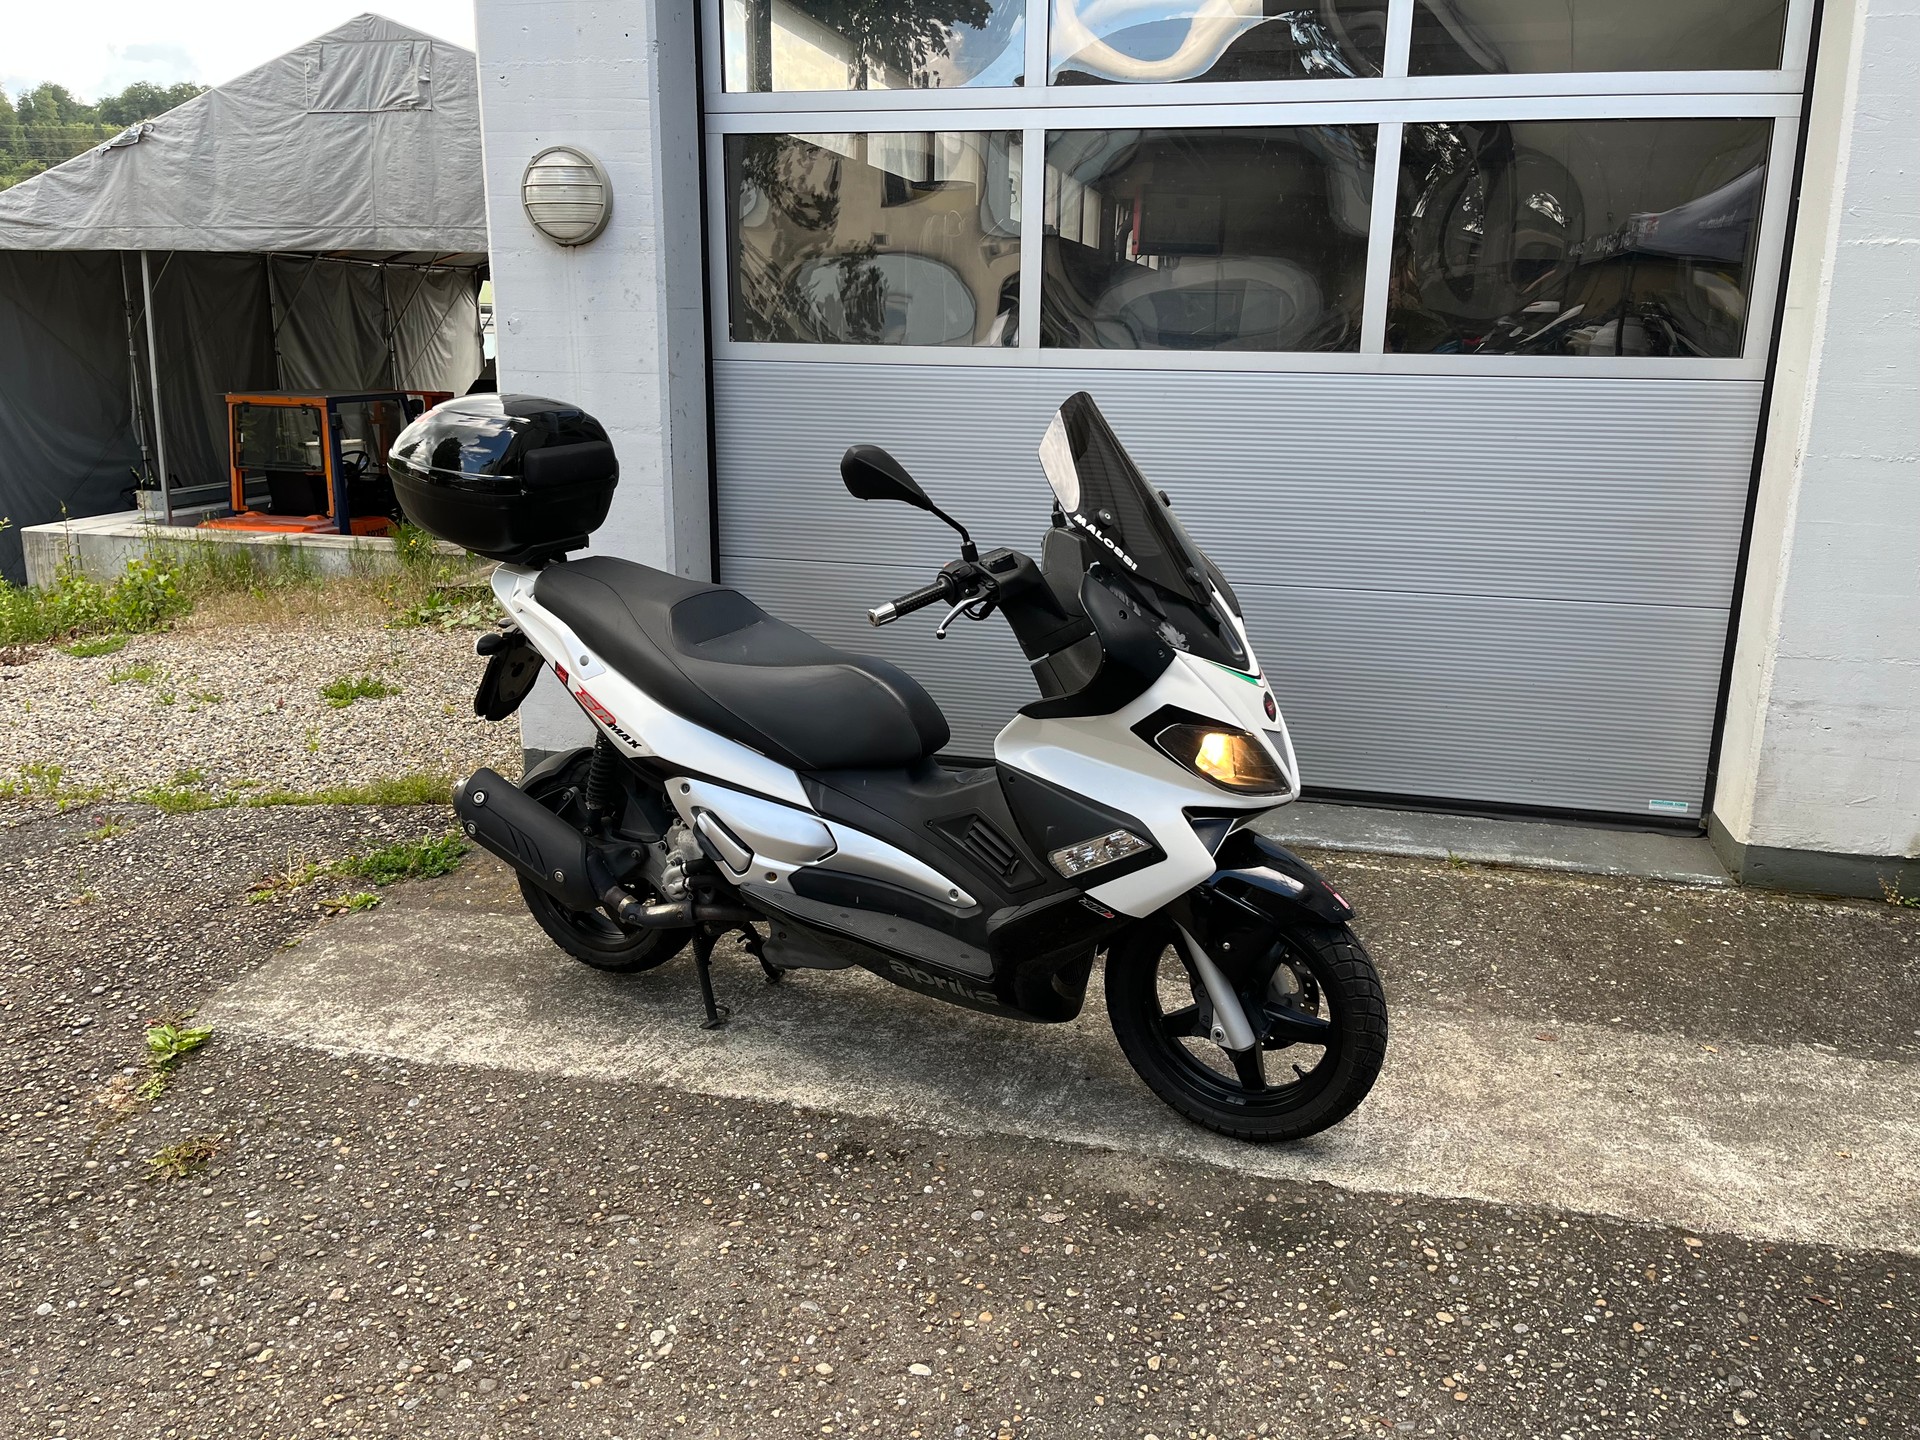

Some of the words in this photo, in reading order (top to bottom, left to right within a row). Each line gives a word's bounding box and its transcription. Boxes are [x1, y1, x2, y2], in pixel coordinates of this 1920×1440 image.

[364, 526, 390, 537] TOYOT
[1073, 514, 1138, 571] MALOSSI
[606, 722, 642, 749] MAX
[888, 959, 1000, 1006] aprilia
